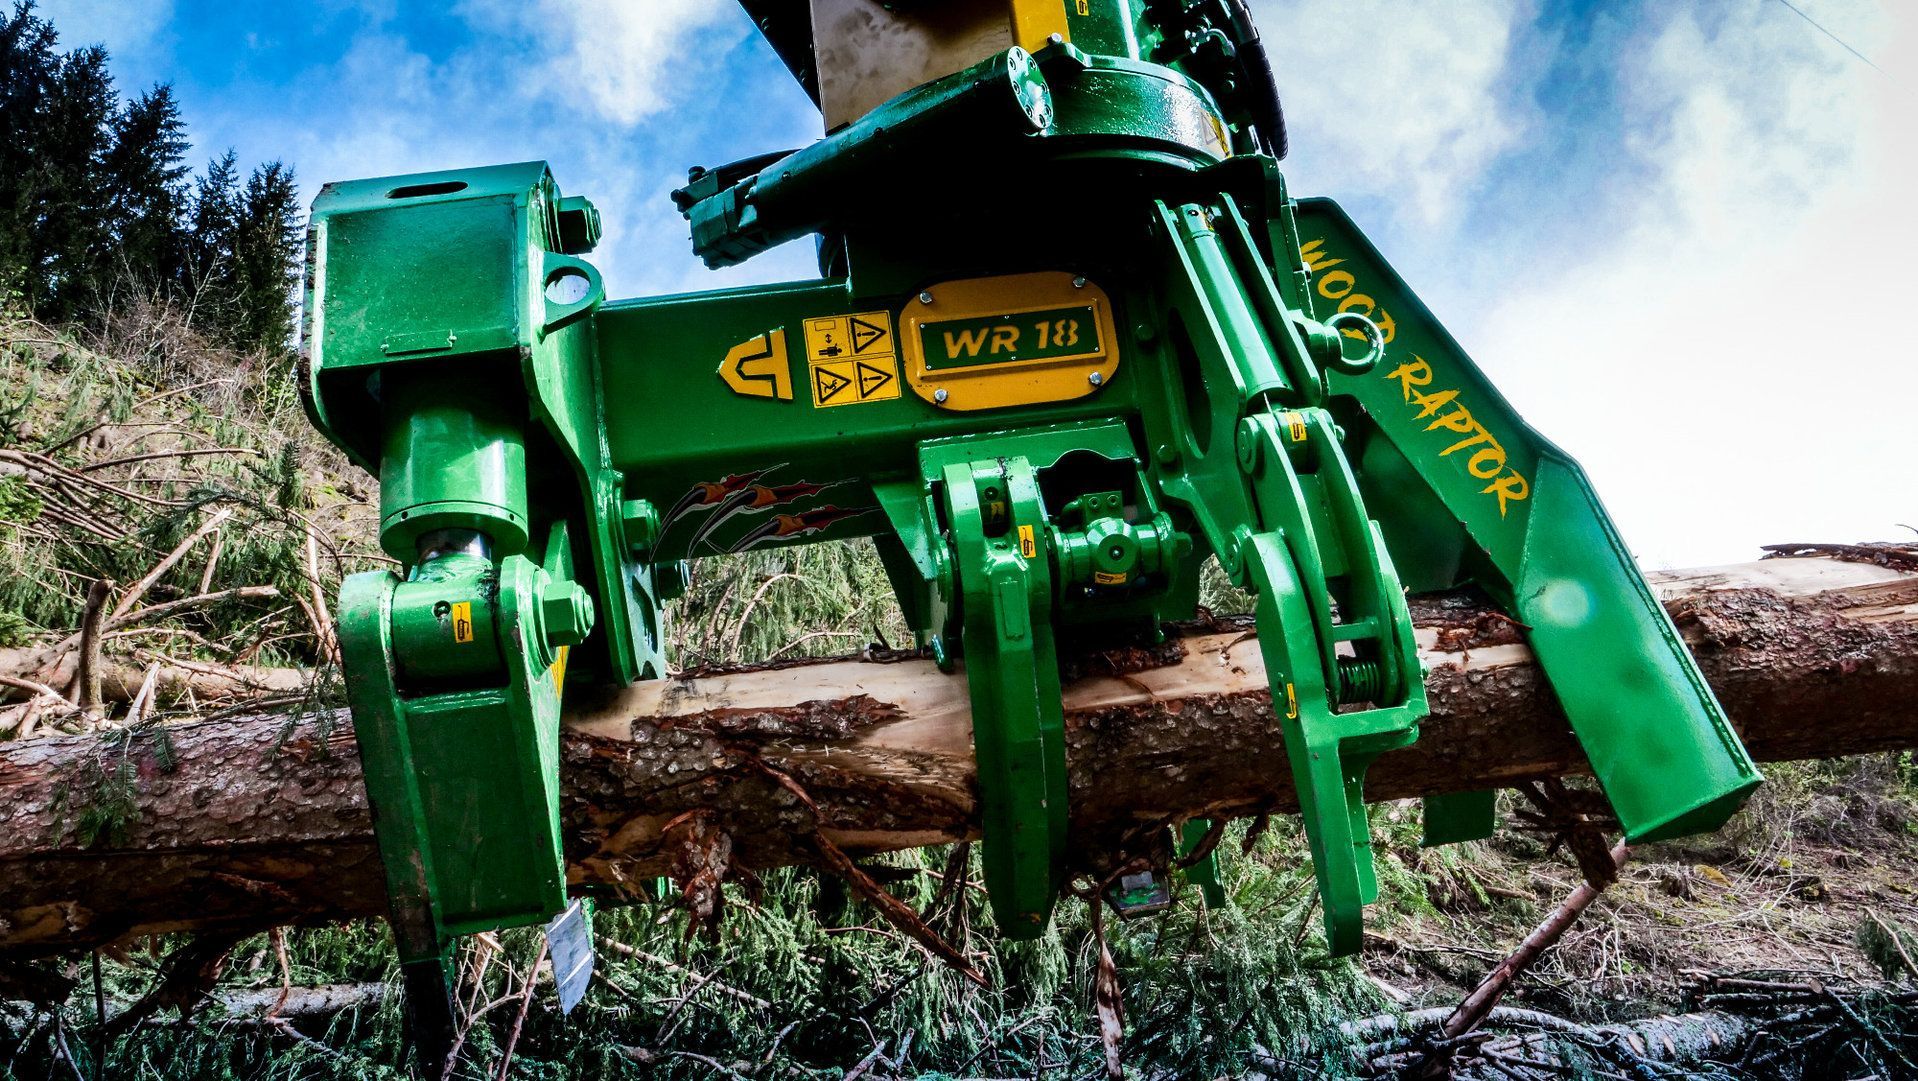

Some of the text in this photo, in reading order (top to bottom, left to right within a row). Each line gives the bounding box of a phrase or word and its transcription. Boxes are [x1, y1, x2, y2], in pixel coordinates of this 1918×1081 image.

[943, 318, 1080, 360] WR 18
[1299, 237, 1530, 521] WOOD RAPTOR
